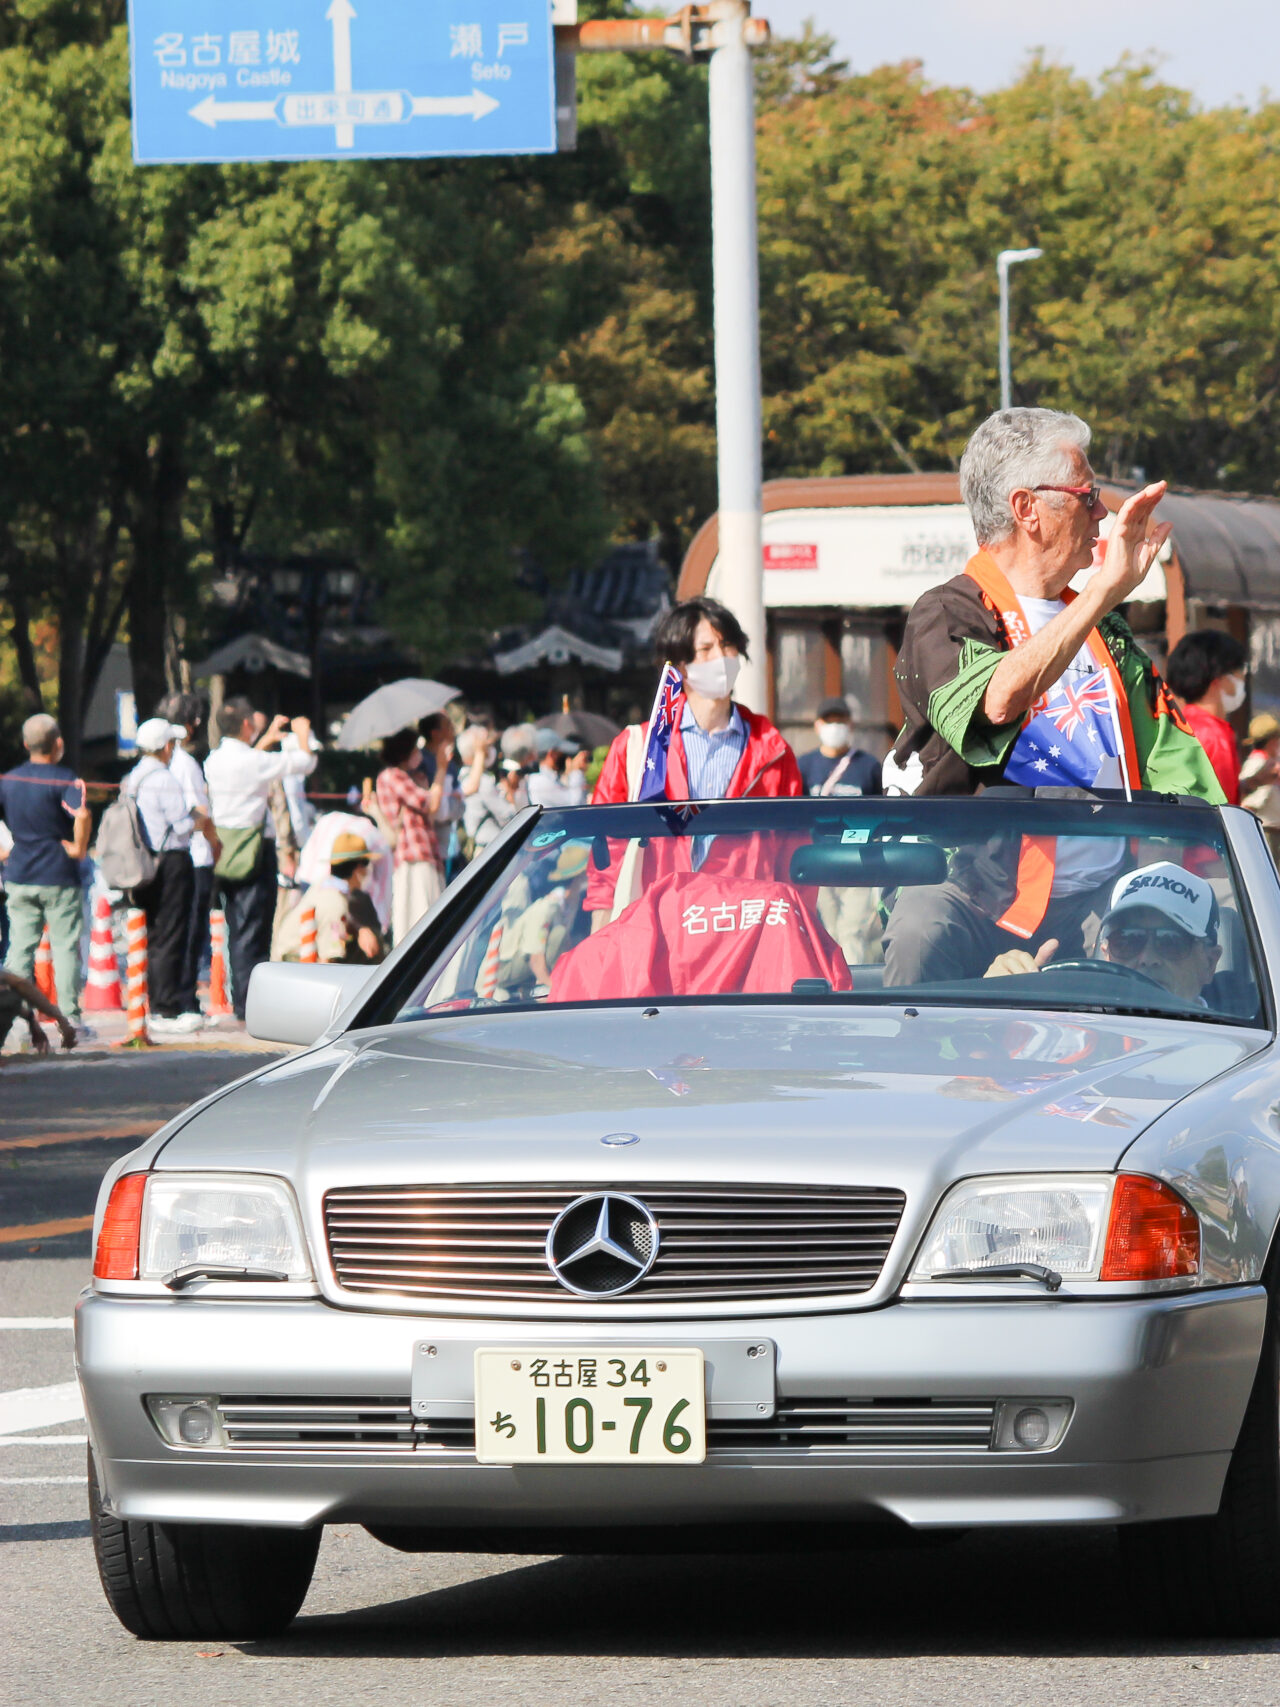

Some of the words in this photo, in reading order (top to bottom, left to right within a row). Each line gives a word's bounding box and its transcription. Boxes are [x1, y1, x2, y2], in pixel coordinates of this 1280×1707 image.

[153, 28, 301, 67] 名古屋城
[450, 22, 529, 58] 瀬戸
[161, 70, 227, 91] Nagoya
[237, 68, 292, 86] Castle
[471, 62, 511, 81] Seto
[902, 541, 969, 565] 市役所
[847, 830, 857, 839] 2
[1121, 874, 1199, 904] SRIXON
[682, 898, 805, 935] 名古屋ま
[529, 1358, 598, 1388] 名古屋
[606, 1358, 651, 1388] 34
[489, 1411, 517, 1439] ち
[536, 1397, 692, 1454] 10-76
